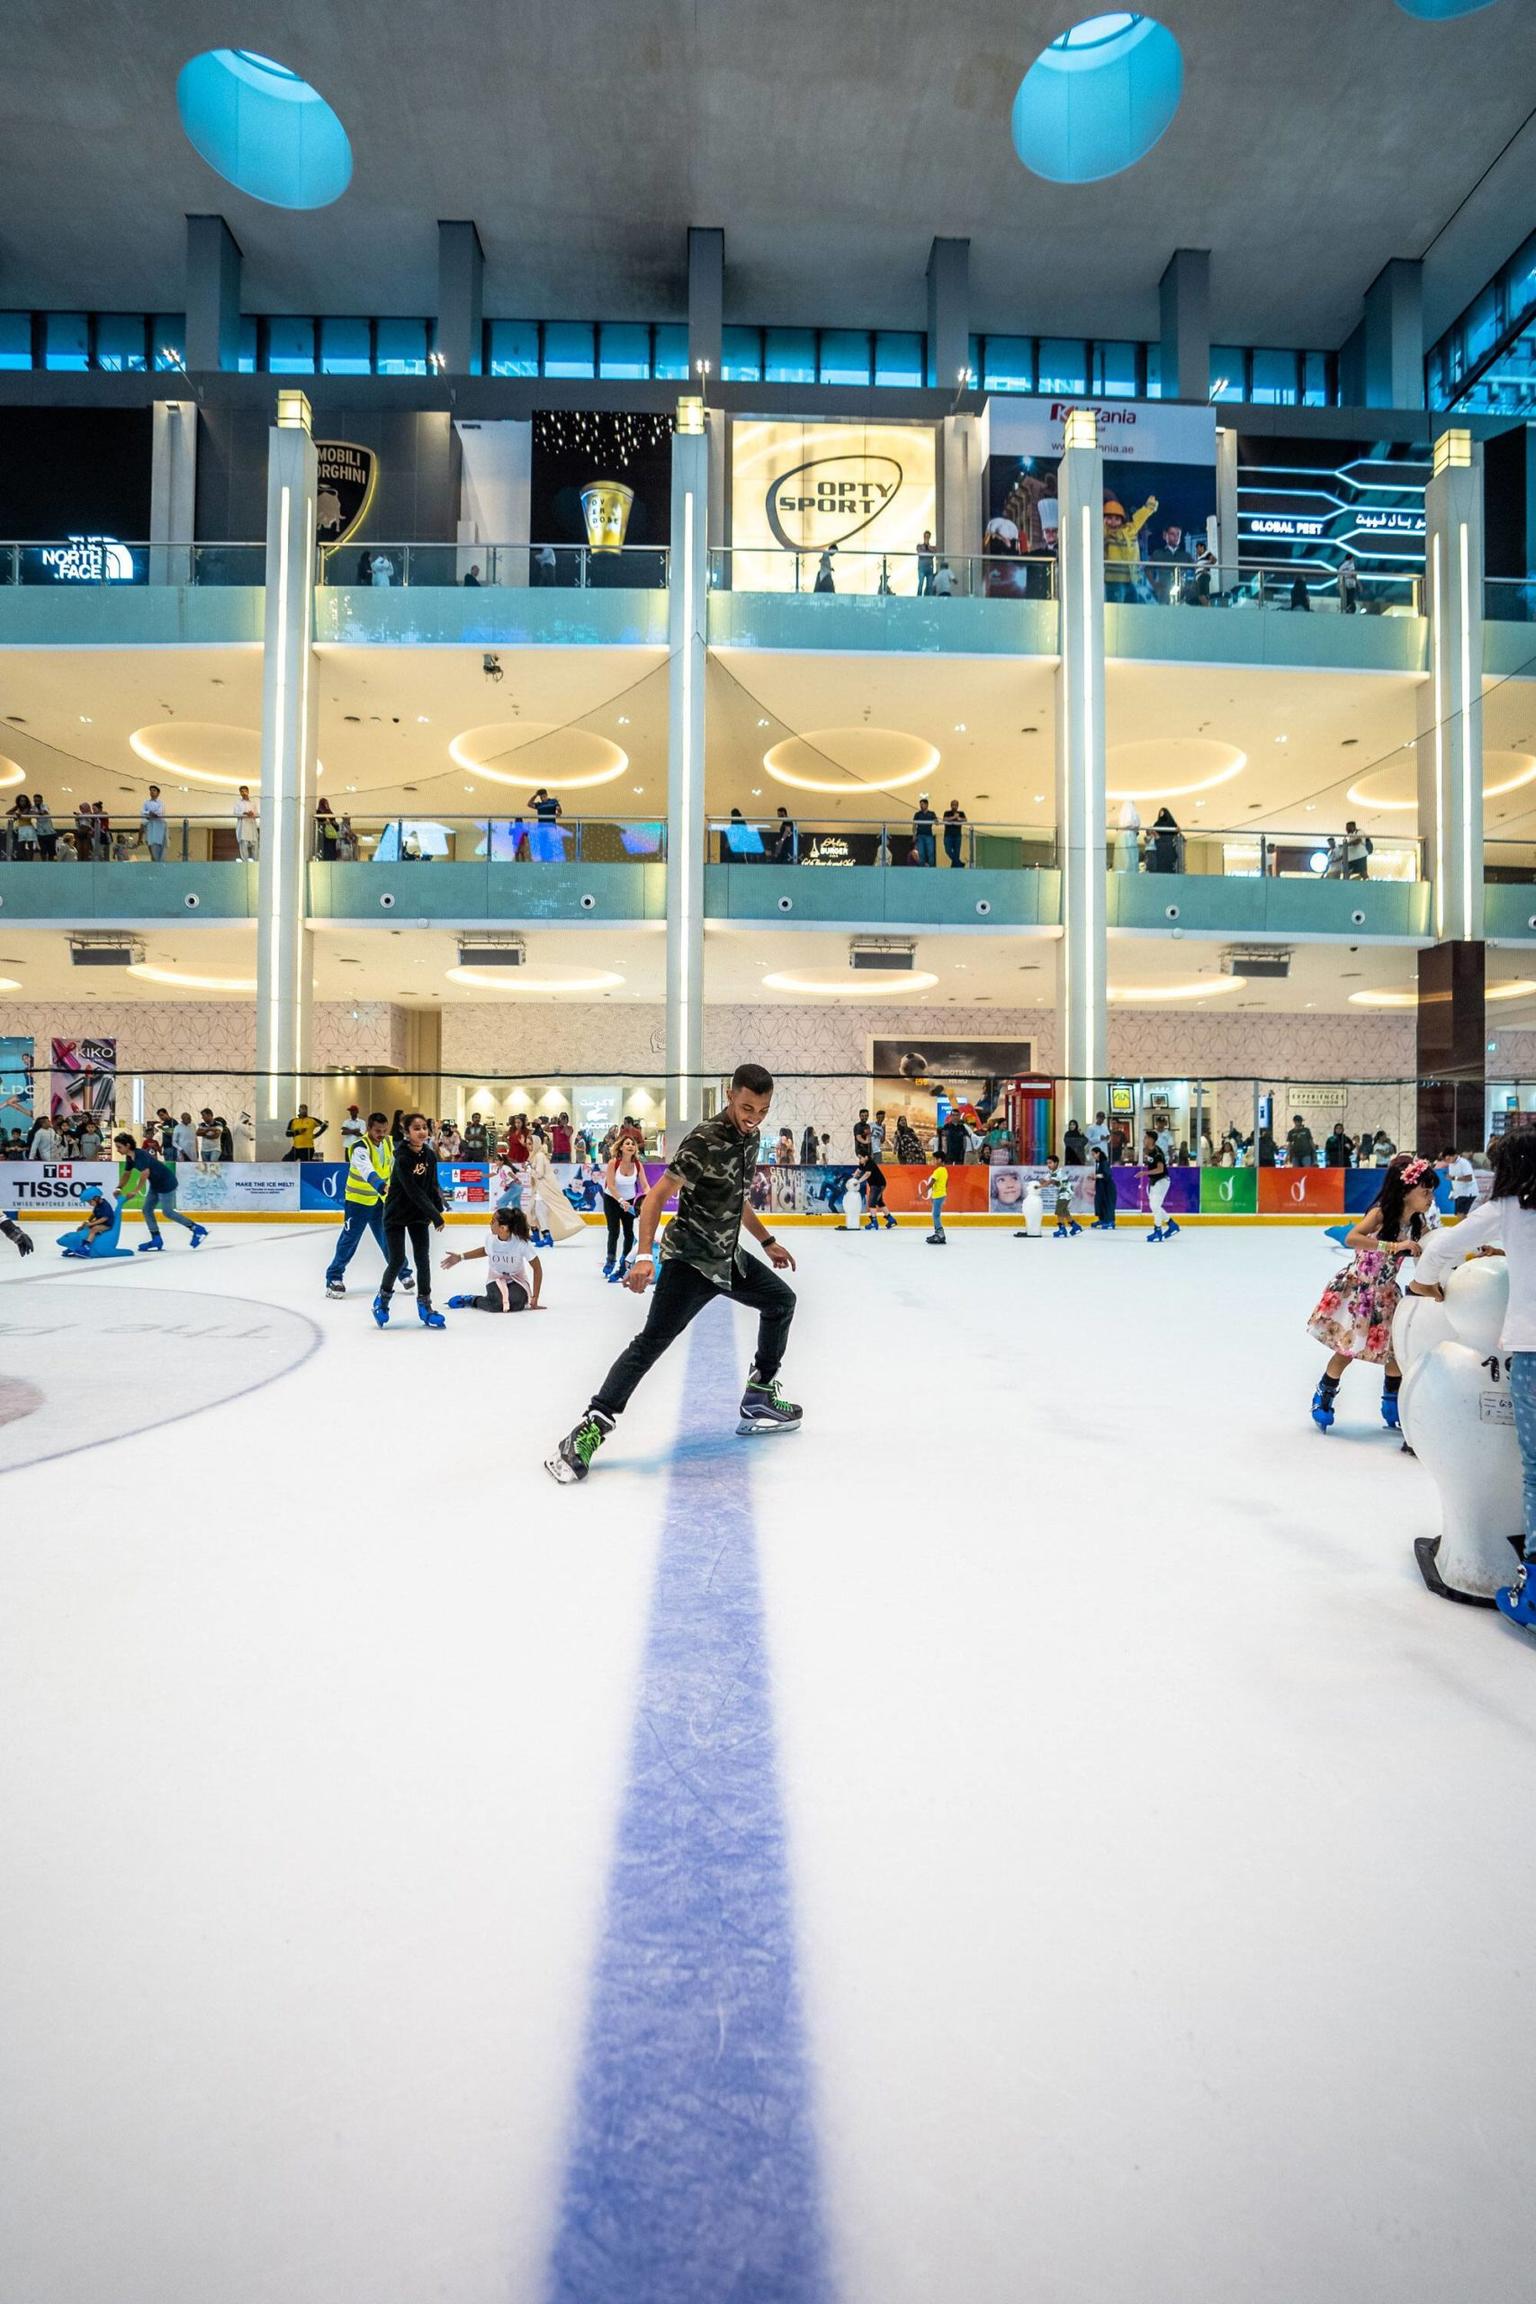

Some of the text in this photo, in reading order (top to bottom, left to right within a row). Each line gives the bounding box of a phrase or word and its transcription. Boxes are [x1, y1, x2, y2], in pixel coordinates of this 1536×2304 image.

[817, 482, 893, 498] OPTY
[780, 496, 875, 514] SPORT
[1251, 519, 1295, 534] GLOBAL
[42, 550, 103, 566] NORTH
[59, 564, 103, 579] FACE
[78, 1047, 114, 1059] KIKO
